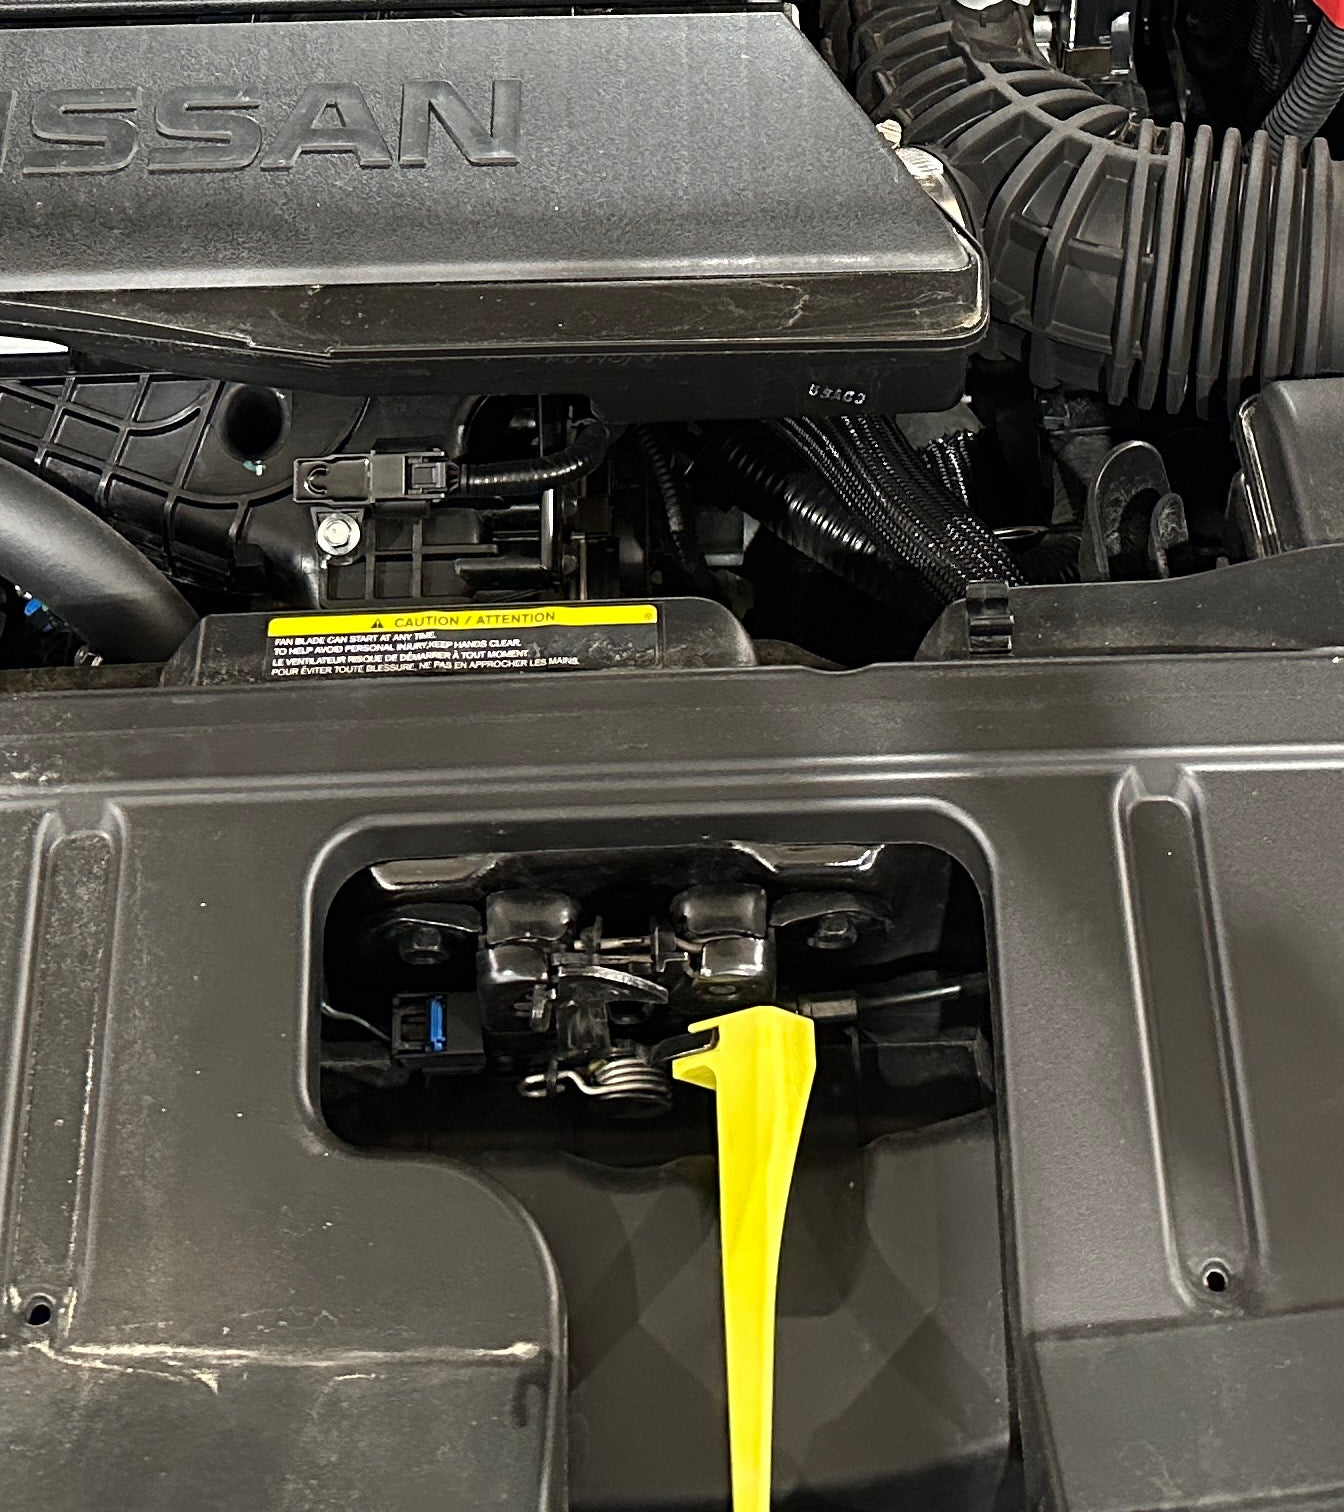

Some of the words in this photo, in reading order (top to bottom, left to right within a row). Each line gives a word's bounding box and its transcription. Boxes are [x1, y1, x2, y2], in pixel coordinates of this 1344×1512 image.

[394, 615, 459, 628] CAUTION
[464, 615, 472, 625] /
[476, 612, 556, 625] ATTENTION
[274, 638, 293, 646] FAN
[295, 637, 325, 645] BLADE
[326, 636, 348, 644] CAN
[349, 634, 378, 642] START
[379, 633, 392, 641] AT
[392, 633, 413, 641] ANY
[274, 648, 287, 656] TO
[289, 646, 313, 655] HELP
[314, 645, 343, 654] AVOID
[344, 643, 394, 653] PERSONAL
[453, 640, 487, 649] HANDS
[272, 658, 284, 667] LE
[286, 656, 347, 666] VENTILATEUR
[347, 654, 383, 663] RISQUE
[384, 654, 398, 662] DE
[399, 651, 452, 662] DÉMARRER
[452, 649, 460, 659] À
[461, 651, 487, 659] TOUT
[271, 668, 299, 676] POUR
[300, 666, 332, 675] ÉVITER
[334, 665, 365, 673] TOUTE
[418, 661, 433, 669] NE
[433, 661, 452, 669] PAS
[453, 661, 467, 669] EN
[468, 659, 528, 669] APPROCHER
[529, 658, 547, 667] LES
